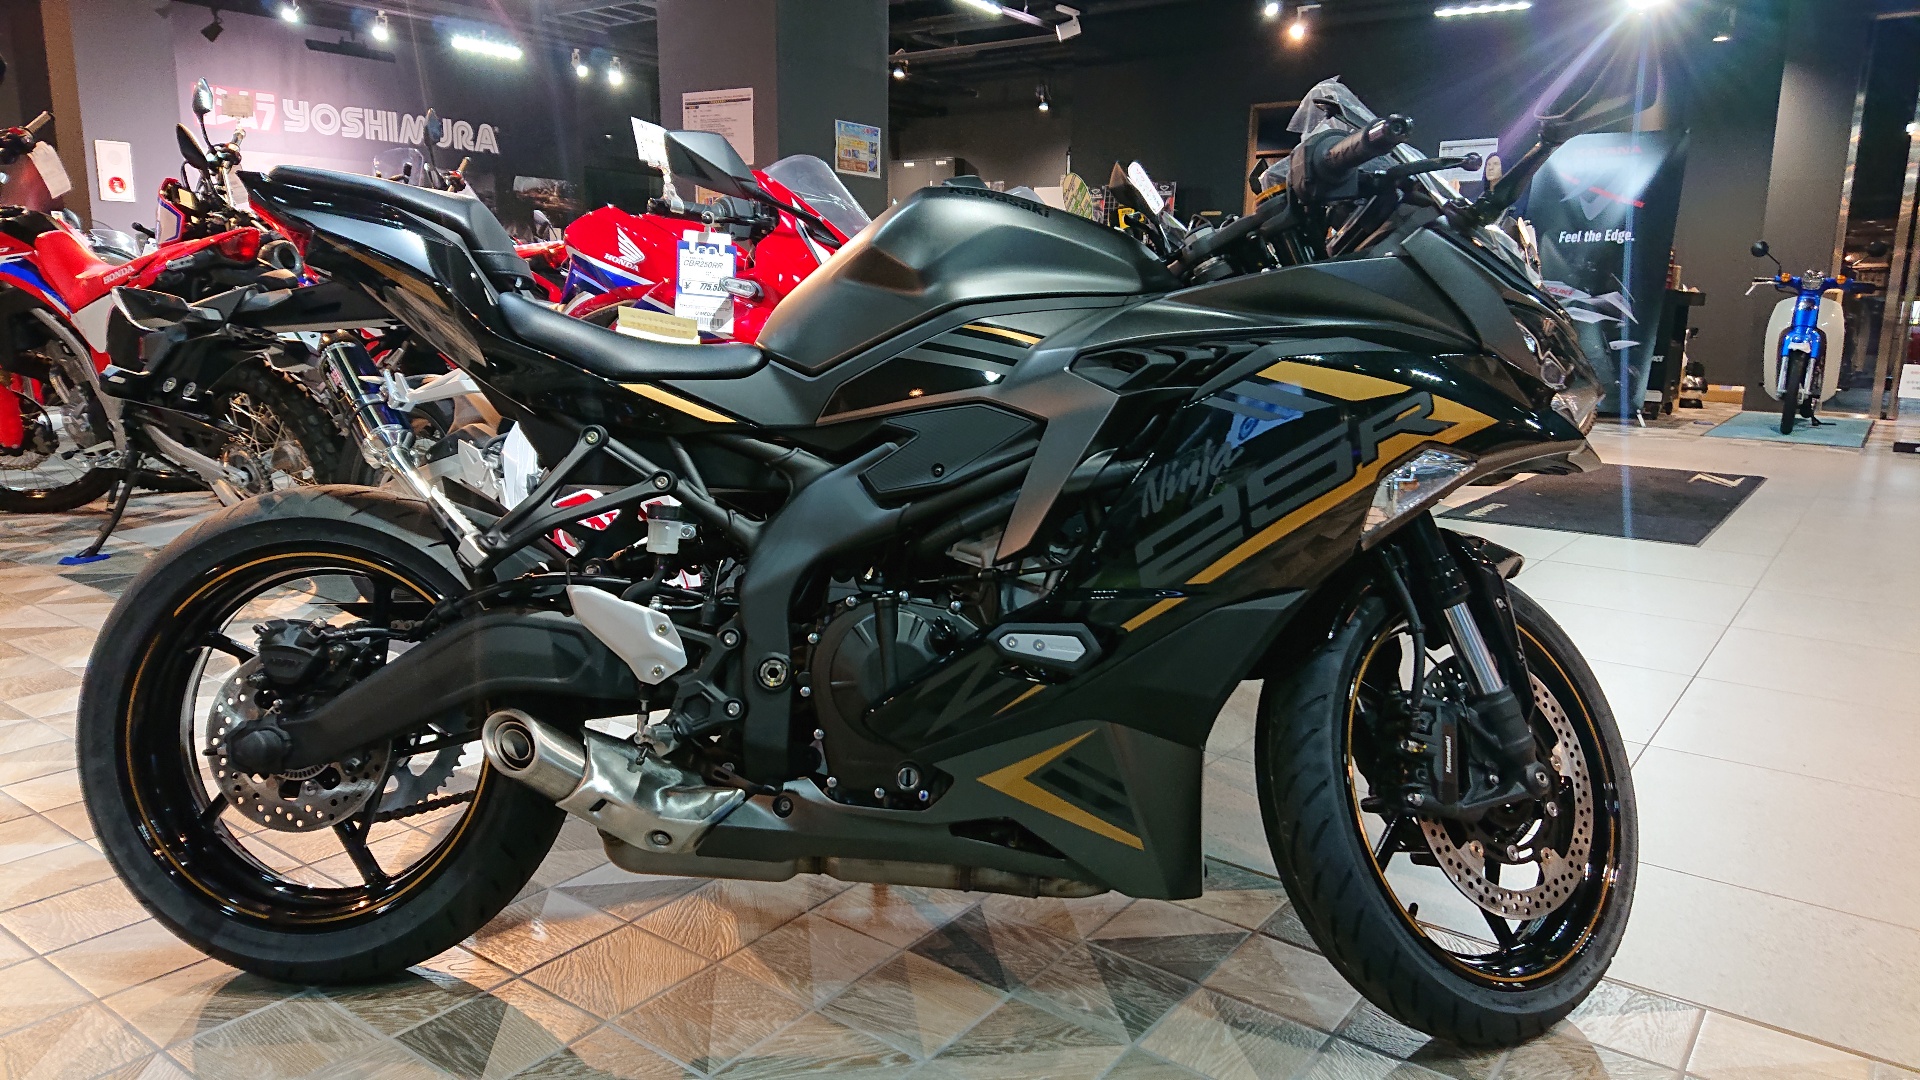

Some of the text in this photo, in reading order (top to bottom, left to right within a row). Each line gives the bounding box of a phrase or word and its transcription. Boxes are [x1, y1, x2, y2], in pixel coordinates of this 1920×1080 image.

[948, 187, 1049, 218] Kawasaki
[1559, 229, 1635, 244] Feel the Edge.
[603, 252, 640, 272] HONDA
[683, 259, 723, 270] CBR250RR
[103, 264, 136, 285] HONDA
[1140, 437, 1244, 518] Ninja
